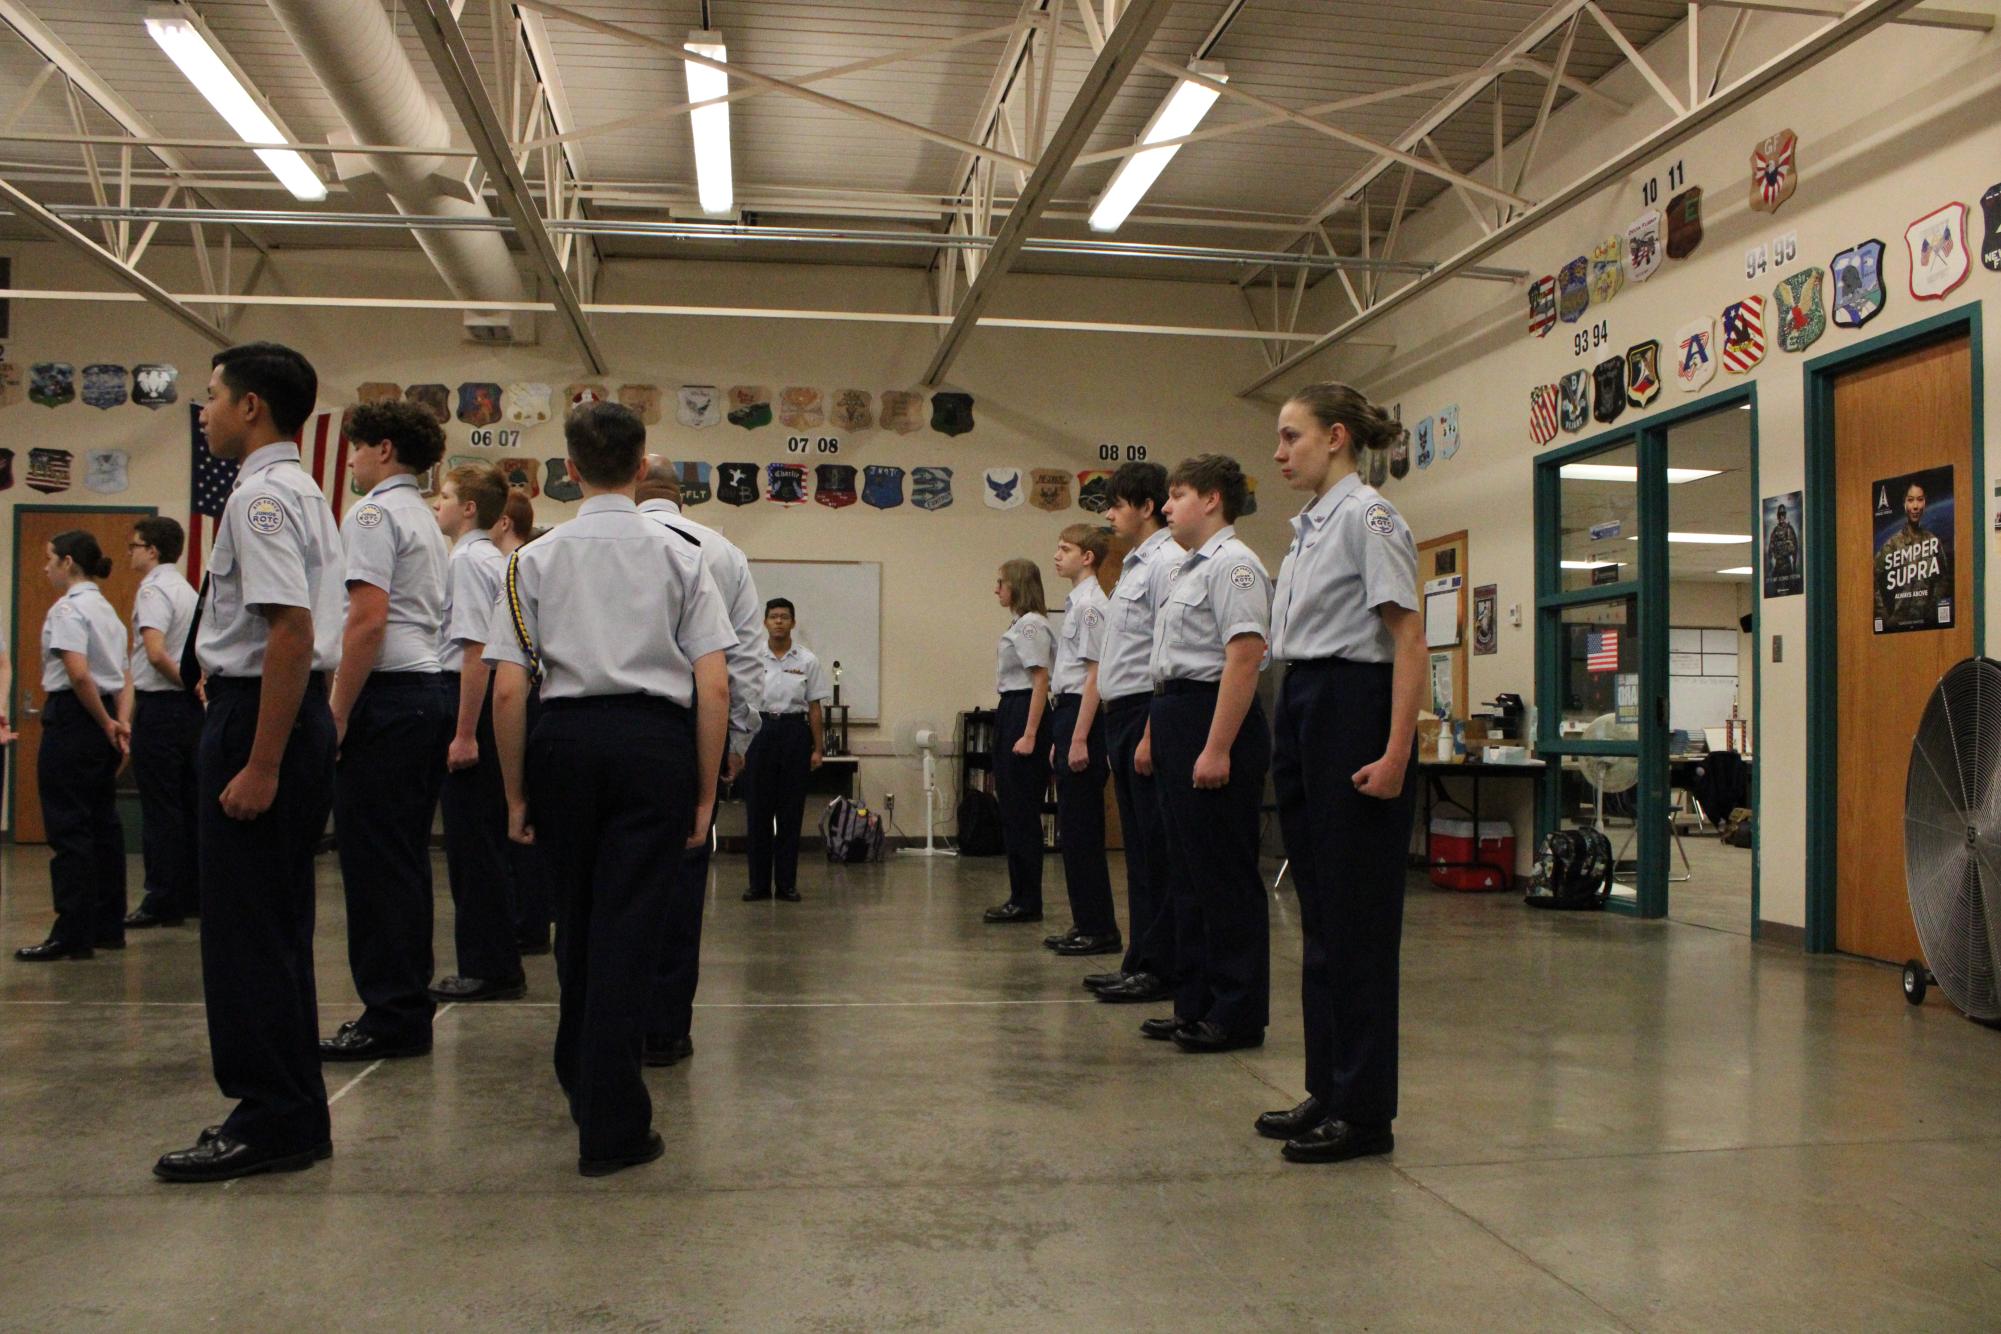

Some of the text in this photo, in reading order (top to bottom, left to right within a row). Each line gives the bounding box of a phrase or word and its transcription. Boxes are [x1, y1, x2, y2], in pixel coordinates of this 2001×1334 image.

[1643, 160, 1683, 206] 10 11
[1746, 235, 1796, 280] 94 95
[1574, 320, 1608, 356] 93 94
[1684, 334, 1708, 372] A
[1571, 375, 1577, 390] B
[471, 430, 520, 447] 06 07
[788, 437, 839, 453] 07 08
[1099, 445, 1146, 461] 08 09
[253, 515, 278, 525] ROTC
[1885, 537, 1939, 570] SEMPER
[1886, 556, 1940, 590] SUPRA
